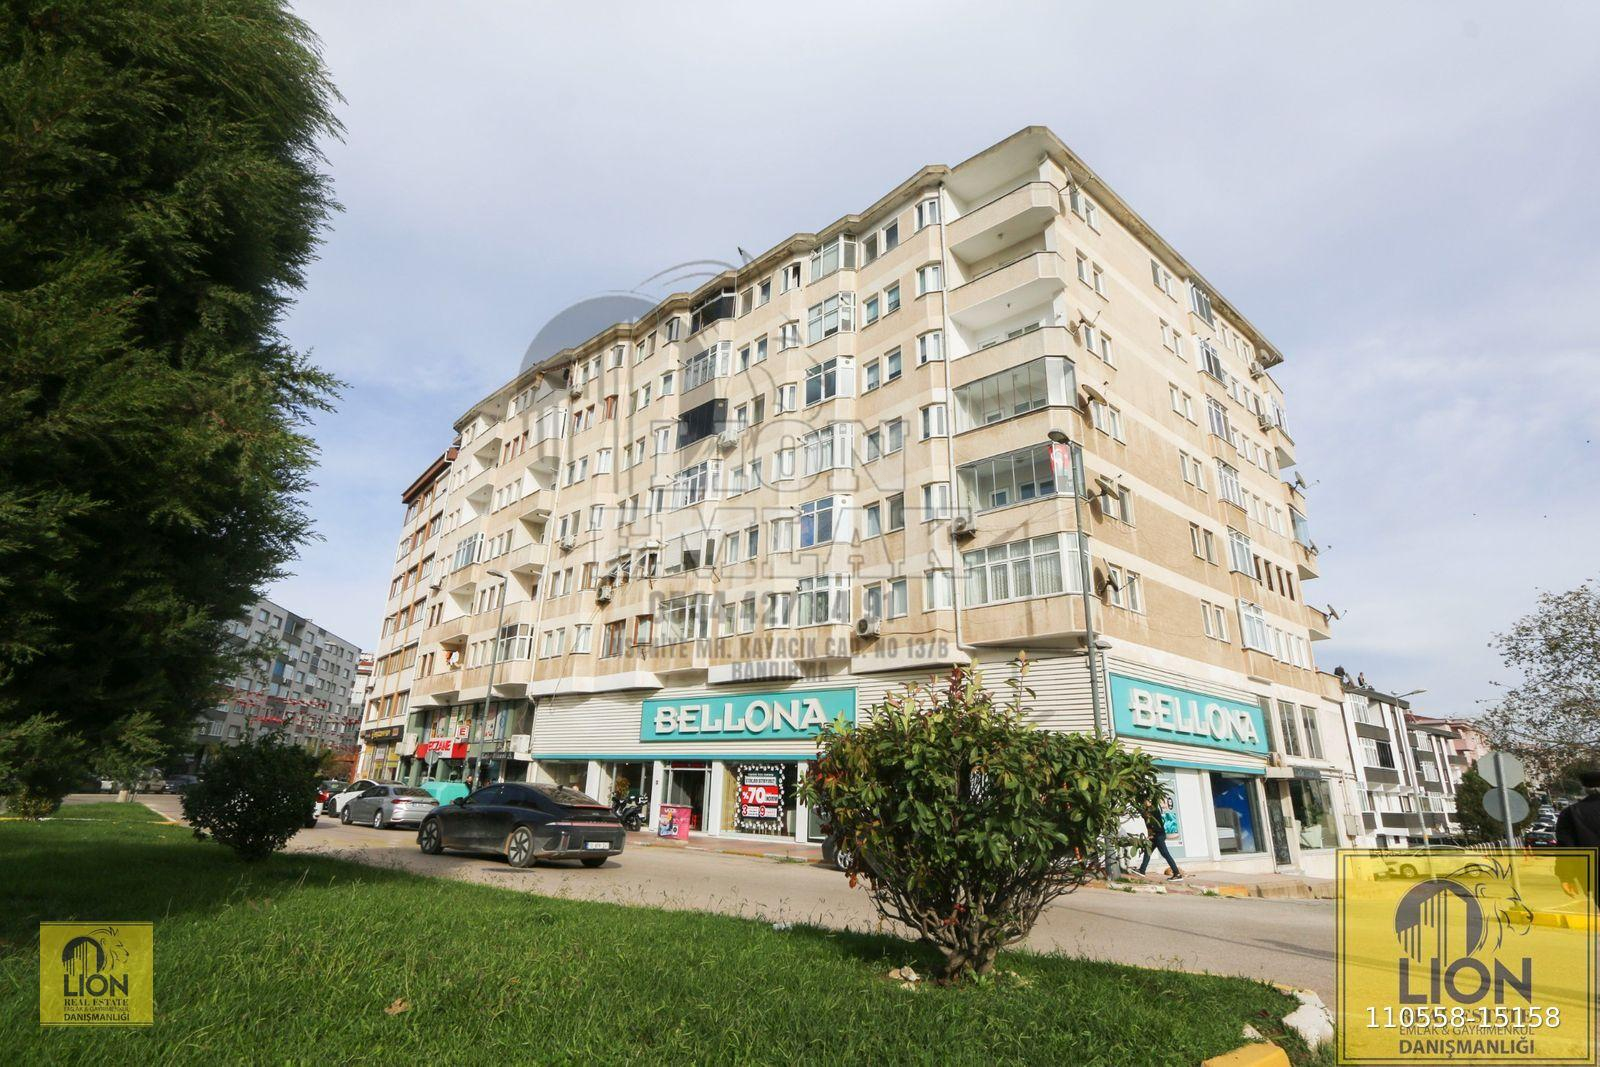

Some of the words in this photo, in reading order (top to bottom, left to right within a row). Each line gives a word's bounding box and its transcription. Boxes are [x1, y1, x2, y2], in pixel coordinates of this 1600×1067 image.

[654, 698, 829, 734] BELLONA
[1129, 687, 1260, 746] BELLONA
[742, 786, 766, 804] %70
